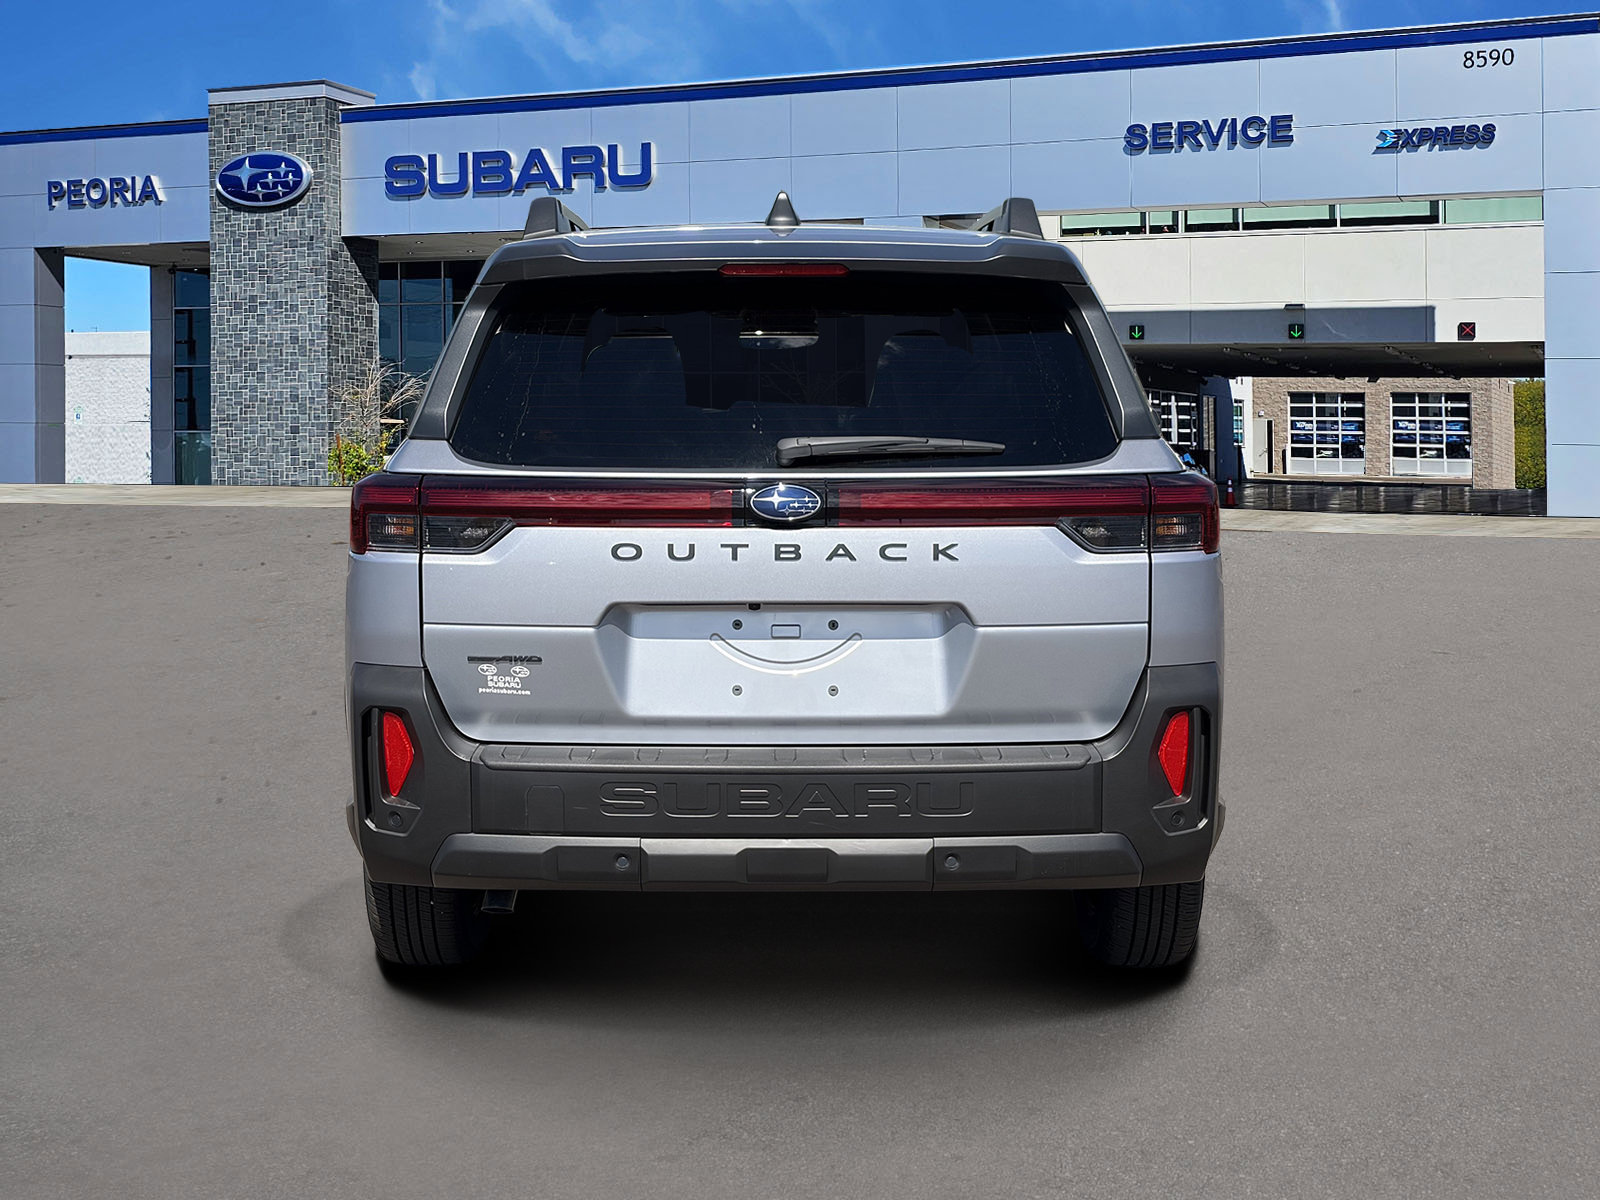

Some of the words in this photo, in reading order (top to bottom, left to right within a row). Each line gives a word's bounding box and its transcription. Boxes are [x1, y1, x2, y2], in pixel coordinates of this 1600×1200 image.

[1463, 48, 1515, 69] 8590
[1125, 114, 1295, 151] SERVICE
[1375, 123, 1497, 148] EXPRESS
[384, 142, 654, 198] SUBARU
[47, 175, 163, 208] PEORIA
[610, 543, 960, 562] OUTBACK
[487, 675, 521, 683] PEORIA
[487, 681, 522, 689] SUBARU
[478, 687, 532, 695] peoriasubaru.com
[599, 781, 974, 818] SUBARU
